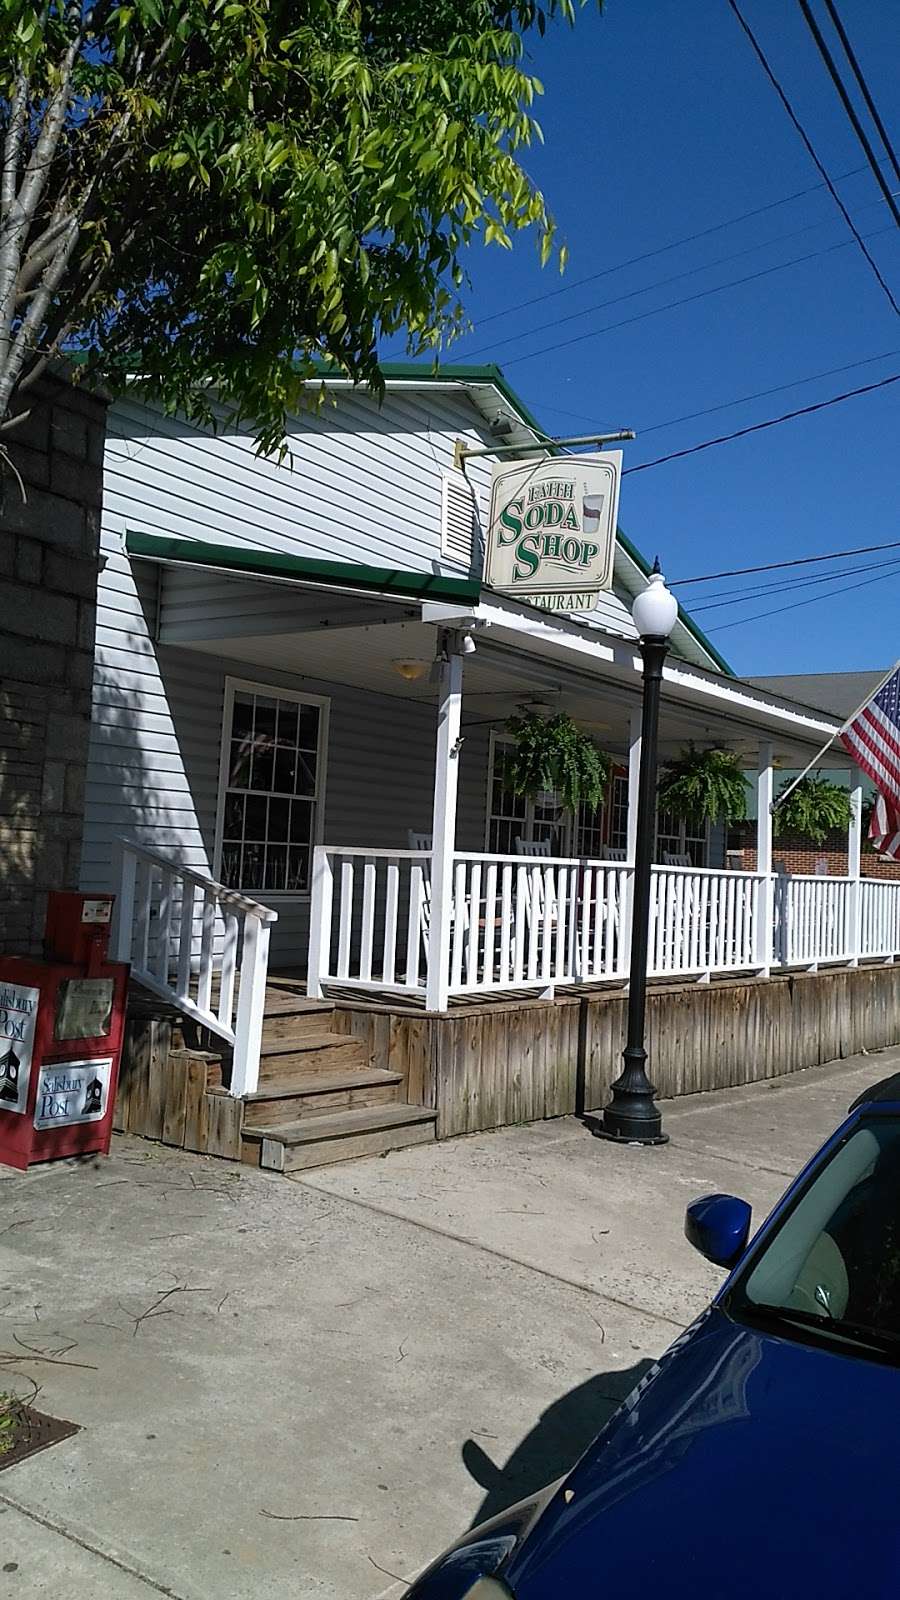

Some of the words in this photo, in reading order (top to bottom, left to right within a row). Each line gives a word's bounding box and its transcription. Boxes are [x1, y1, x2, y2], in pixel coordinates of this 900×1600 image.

[529, 481, 575, 503] FAITH
[498, 496, 580, 547] SODA
[512, 531, 599, 583] SHOP
[526, 594, 594, 610] STAURANT
[0, 987, 35, 1016] alisbury
[0, 1010, 26, 1040] Post
[41, 1074, 84, 1094] Salisbury
[40, 1096, 70, 1118] Post
